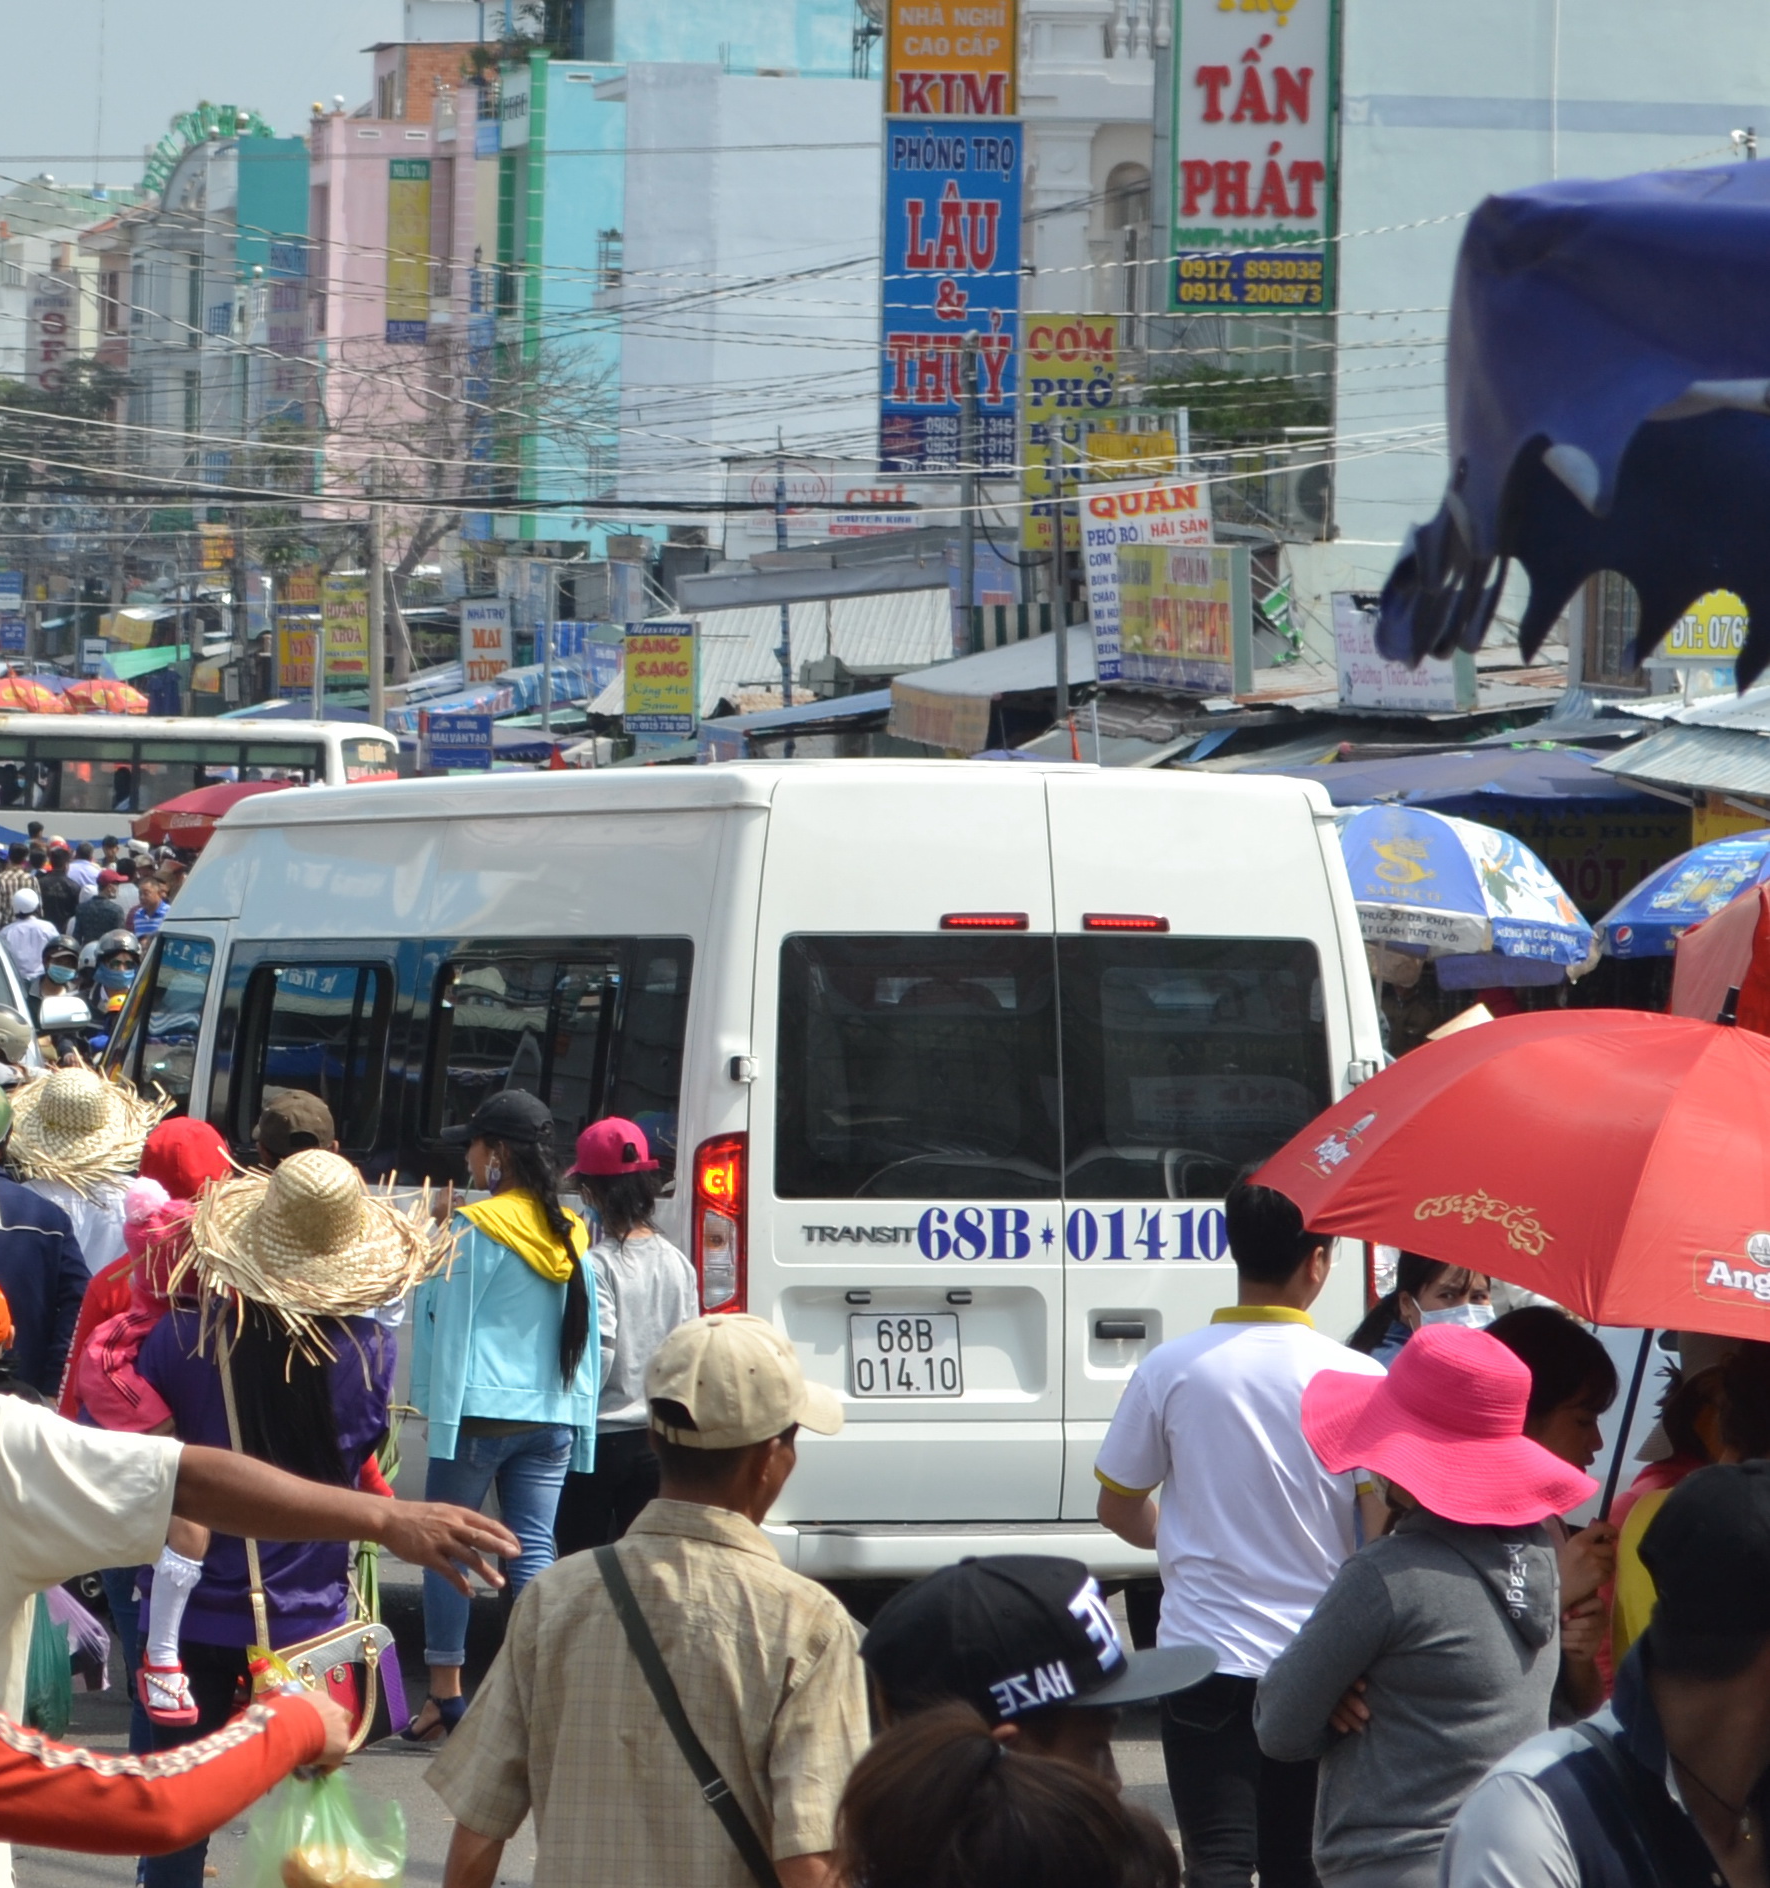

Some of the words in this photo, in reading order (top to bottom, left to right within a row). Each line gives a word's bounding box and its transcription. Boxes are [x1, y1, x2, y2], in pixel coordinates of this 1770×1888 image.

[899, 1, 944, 27] NHÀ
[904, 36, 950, 56] CAO
[956, 29, 1000, 57] CẤP
[896, 70, 1008, 115] KIM
[1196, 33, 1314, 124] TẤN
[893, 127, 967, 172] PHÒNG
[972, 135, 1015, 182] TRỌ
[1181, 141, 1326, 218] PHÁT
[905, 178, 1001, 272] LÂU
[1180, 259, 1239, 279] 0917.
[1243, 259, 1323, 280] 893032
[935, 277, 968, 321] &
[1180, 282, 1239, 303] 0914.
[1243, 283, 1323, 303] 200273
[1028, 319, 1115, 362] CƠM
[1030, 366, 1115, 409] PHỞ
[1089, 480, 1199, 520] QUÁN
[1087, 522, 1116, 547] PHỞ
[1119, 521, 1139, 542] BÒ
[1150, 516, 1176, 537] HẢI
[1179, 514, 1209, 534] SẢN
[471, 627, 503, 648] MAI
[626, 637, 681, 656] SANG
[630, 622, 690, 636] Massage
[1671, 615, 1704, 649] ĐT:
[634, 659, 691, 679] SANG
[1366, 882, 1443, 903] SABECO
[801, 1224, 918, 1246] TRANSIT
[917, 1206, 1031, 1261] 68B
[1066, 1207, 1229, 1262] 01410
[876, 1319, 934, 1354] 68B
[856, 1356, 959, 1392] 014.10
[1503, 1543, 1529, 1619] A-Eagle
